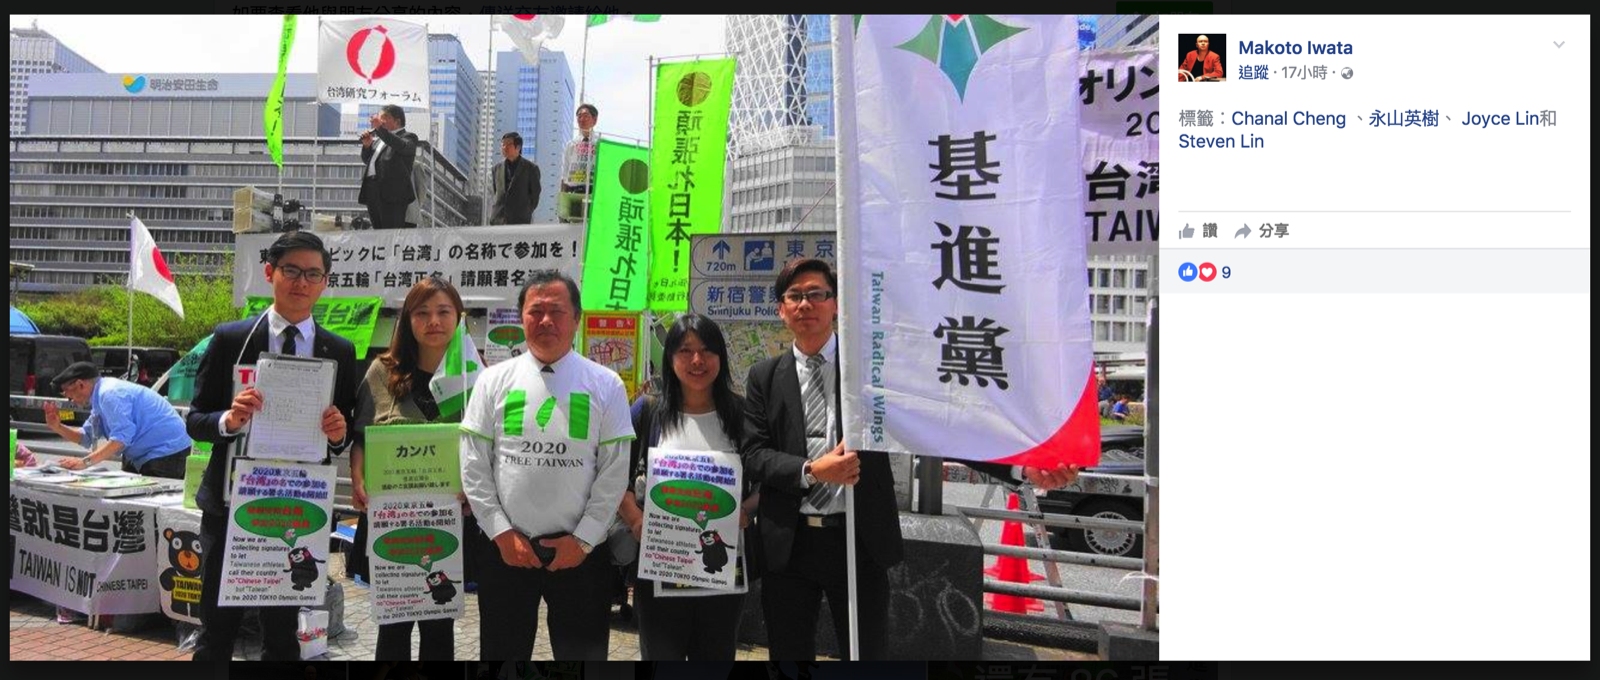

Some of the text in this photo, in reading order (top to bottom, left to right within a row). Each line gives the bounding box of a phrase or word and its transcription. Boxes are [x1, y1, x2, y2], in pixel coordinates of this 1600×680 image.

[150, 78, 218, 91] 明治安田生命
[327, 86, 421, 102] 台湾研究フォーラム
[706, 262, 736, 271] 720m
[928, 130, 1010, 391] 基進黨
[870, 272, 885, 443] Taiwan Radical Wings
[521, 441, 567, 454] 2020
[505, 455, 583, 468] FREE TAIWAN
[19, 549, 148, 598] TAIWAN IS NOT CHINESE TAIPEI
